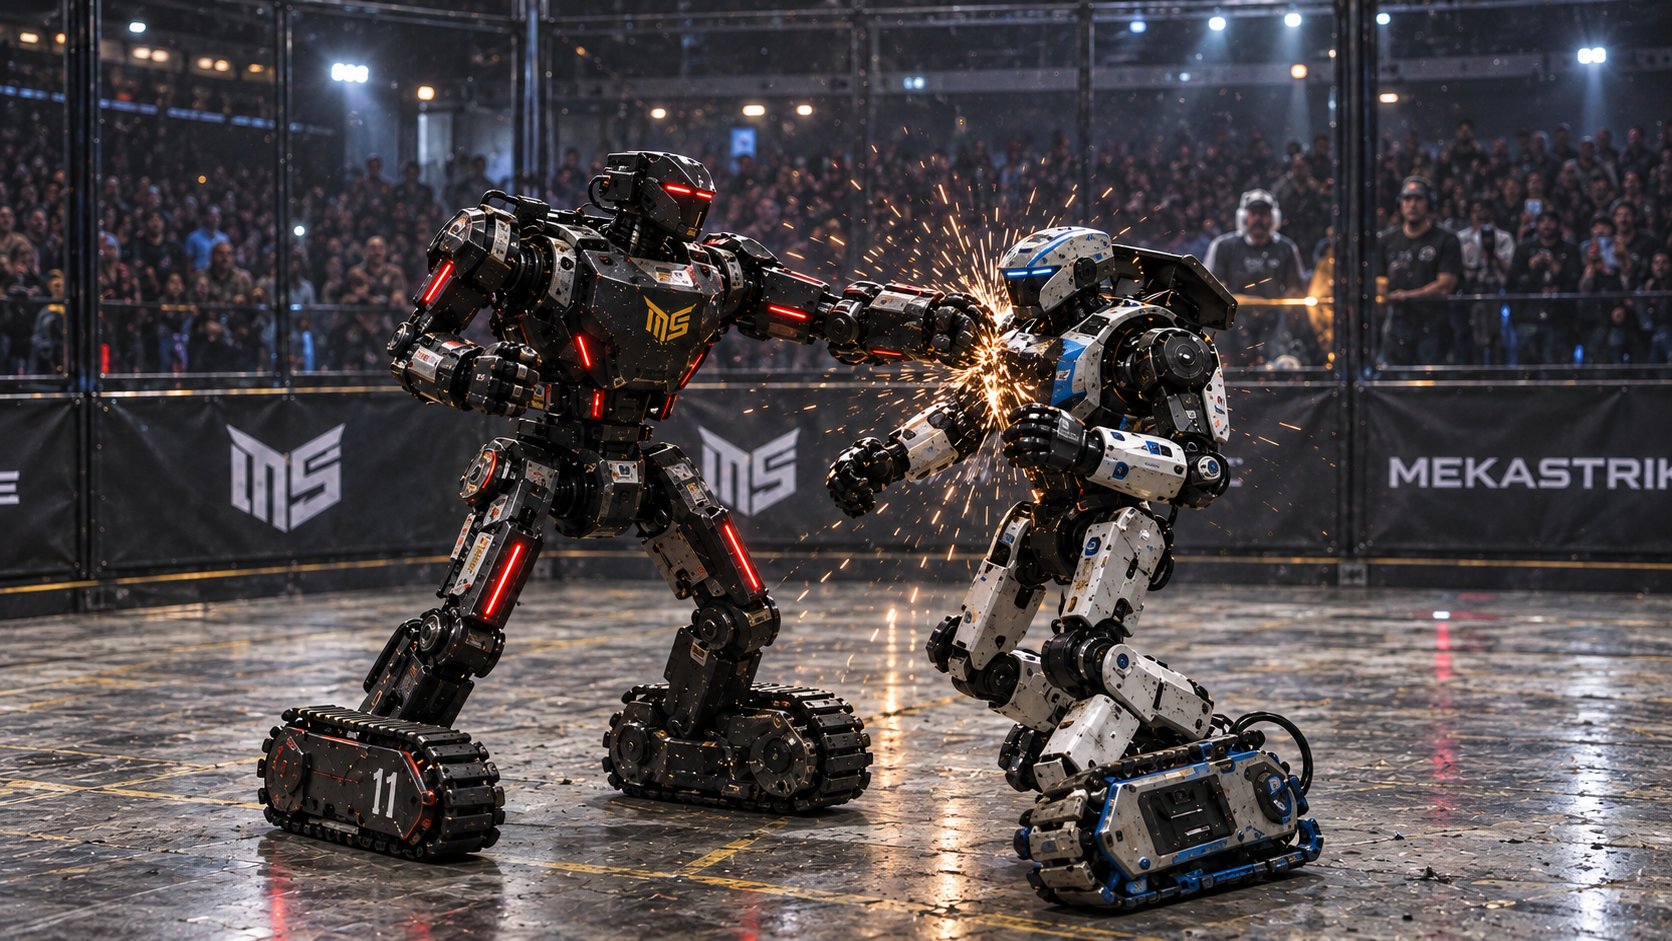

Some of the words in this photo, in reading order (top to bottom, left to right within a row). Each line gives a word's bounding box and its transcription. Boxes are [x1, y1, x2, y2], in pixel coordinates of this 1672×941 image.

[642, 294, 697, 343] MS
[226, 423, 346, 533] MS
[697, 425, 801, 517] MS
[372, 767, 398, 819] 11
